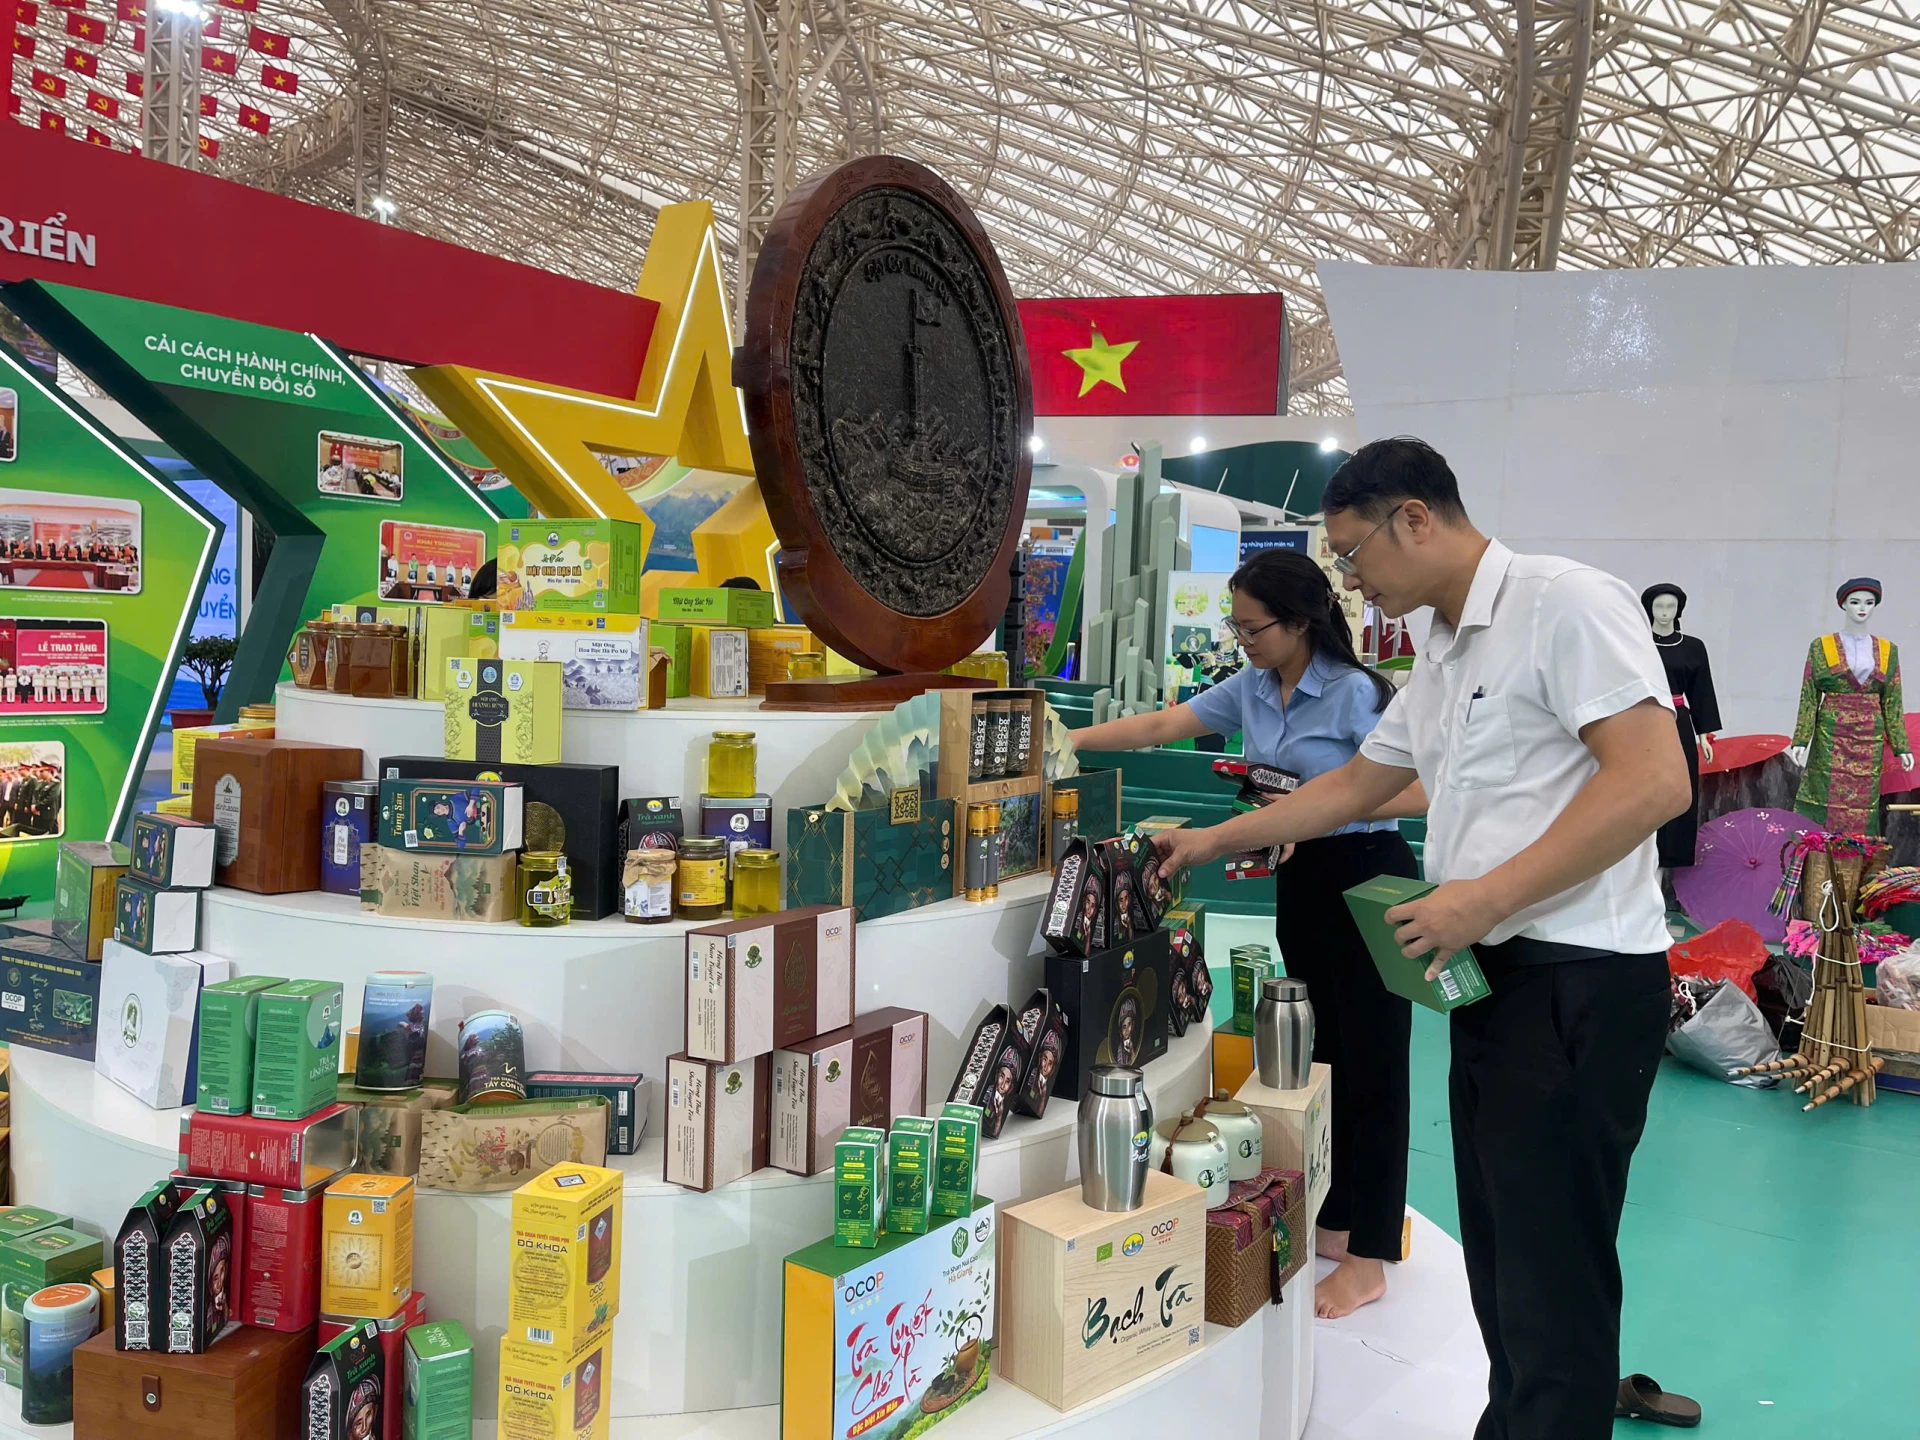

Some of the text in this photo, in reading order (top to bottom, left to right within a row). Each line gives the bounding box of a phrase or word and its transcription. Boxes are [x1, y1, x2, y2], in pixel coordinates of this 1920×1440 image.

[144, 334, 347, 386] CẢI CÁCH HÀNH CHÍNH,
[180, 363, 316, 399] CHUYỂN ĐỔI SỐ
[50, 643, 72, 652] TRAO
[74, 642, 97, 653] TẶNG
[653, 812, 675, 821] xanh
[411, 861, 422, 907] Việt Shan
[825, 926, 843, 937] OCOP
[5, 993, 22, 1002] OCOP
[899, 1033, 916, 1045] OCOP
[500, 1080, 516, 1090] CÔN
[1151, 1217, 1179, 1237] OCOP
[536, 1240, 568, 1254] KHOA
[950, 1264, 961, 1274] Shan
[970, 1255, 979, 1264] Cao
[948, 1266, 973, 1284] Hà Giang
[845, 1271, 884, 1302] OCOP
[886, 1288, 935, 1356] Tuyết
[1082, 1286, 1144, 1349] Bạch
[358, 1353, 377, 1370] xanh
[523, 1388, 554, 1401] KHOA
